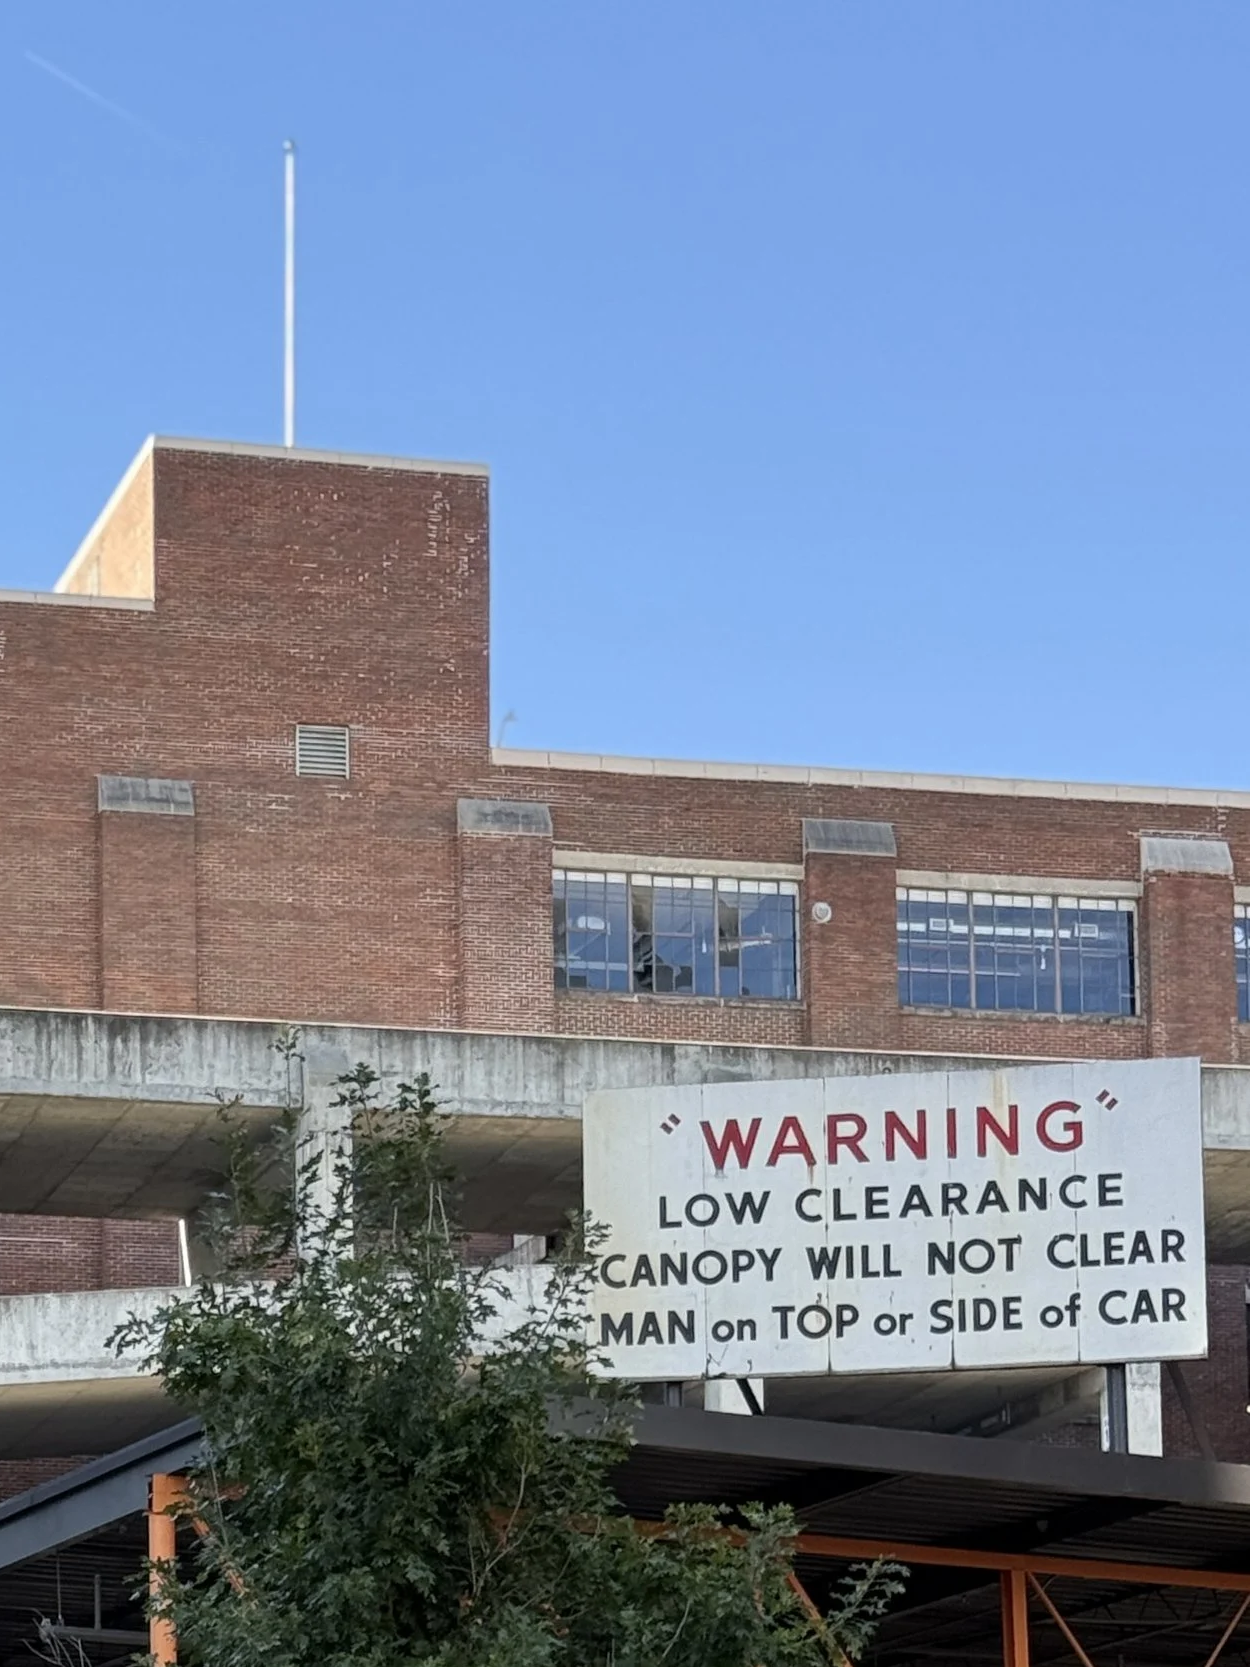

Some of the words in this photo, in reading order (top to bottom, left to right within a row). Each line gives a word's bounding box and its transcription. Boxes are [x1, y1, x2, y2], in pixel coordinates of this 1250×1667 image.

[659, 1190, 771, 1229] LOW
[795, 1172, 1124, 1223] CLEARANCE
[600, 1247, 782, 1289] CANOPY
[805, 1244, 902, 1281] WILL
[927, 1234, 1024, 1276] NOT
[1046, 1229, 1186, 1269] CLEAR
[600, 1309, 696, 1346] MAN
[711, 1318, 758, 1343] on
[771, 1303, 860, 1340] TOP
[873, 1312, 915, 1337] or
[930, 1296, 1024, 1334] SIDE
[1039, 1292, 1082, 1329] of
[1098, 1288, 1187, 1325] CAR
